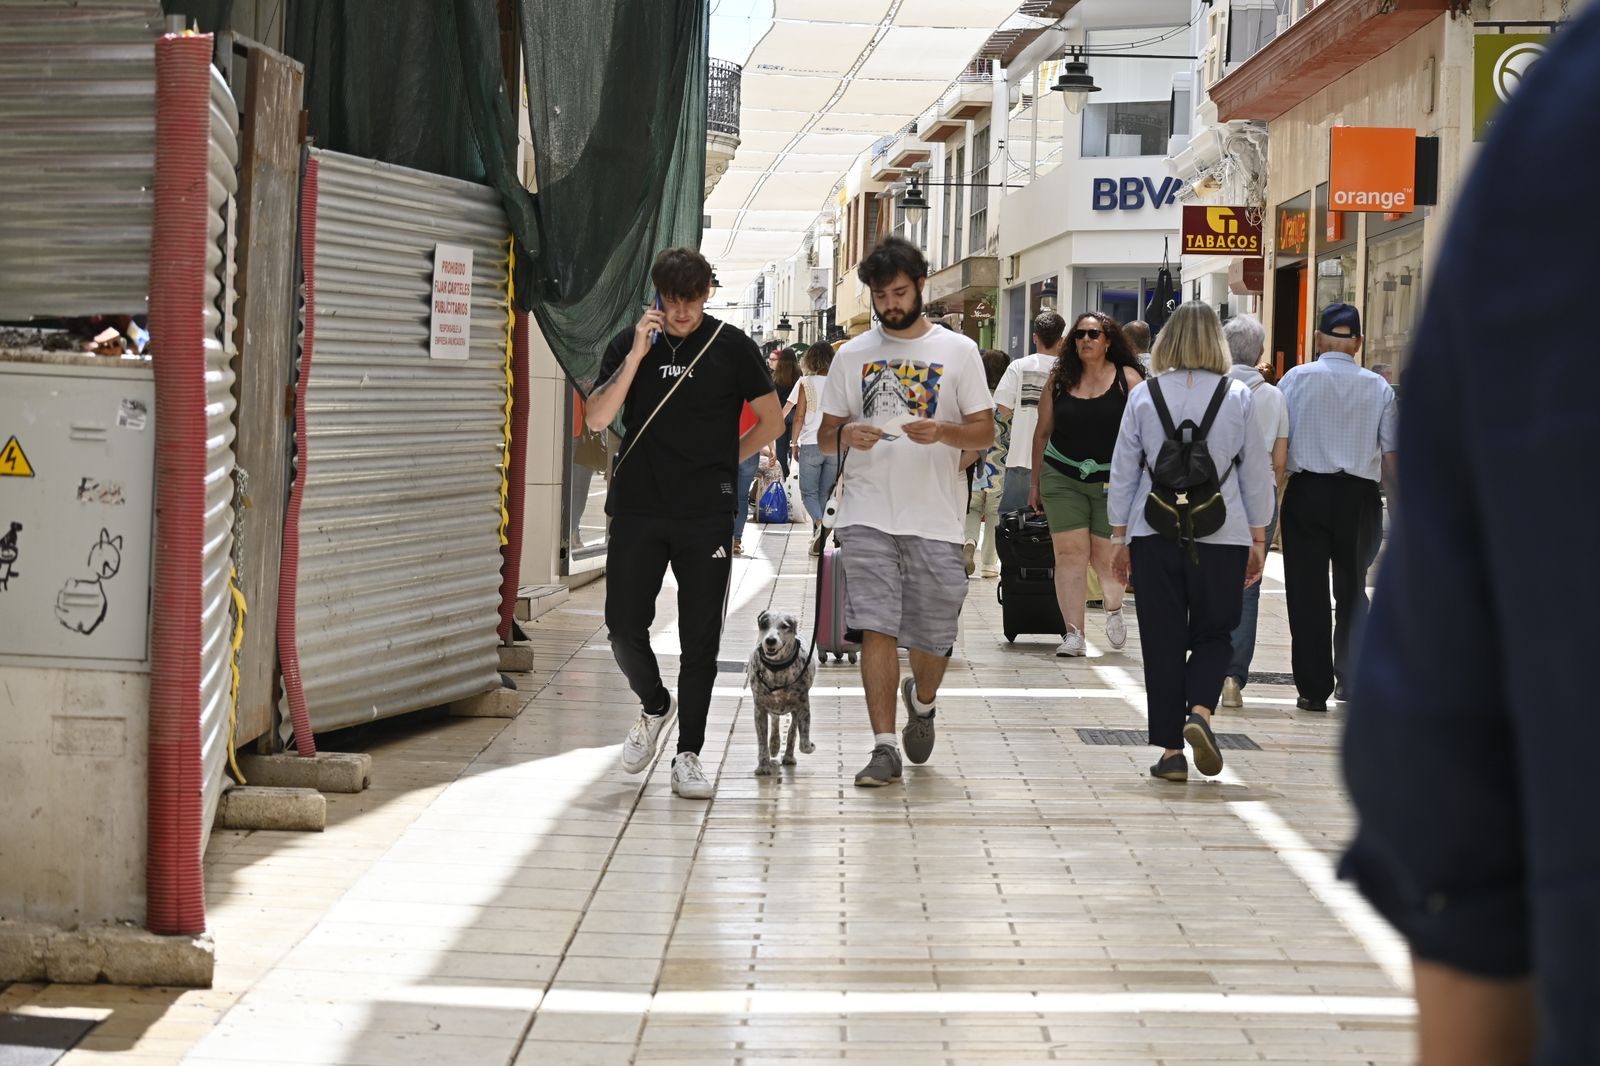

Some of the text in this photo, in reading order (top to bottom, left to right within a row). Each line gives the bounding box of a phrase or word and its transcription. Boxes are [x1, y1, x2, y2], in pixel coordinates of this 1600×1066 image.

[1334, 190, 1406, 209] orange
[1186, 234, 1258, 248] TABACOS
[442, 260, 466, 276] PROHIBIDO
[434, 280, 470, 296] FIJAR CARTELES
[434, 300, 468, 316] PUBLICITARIOS
